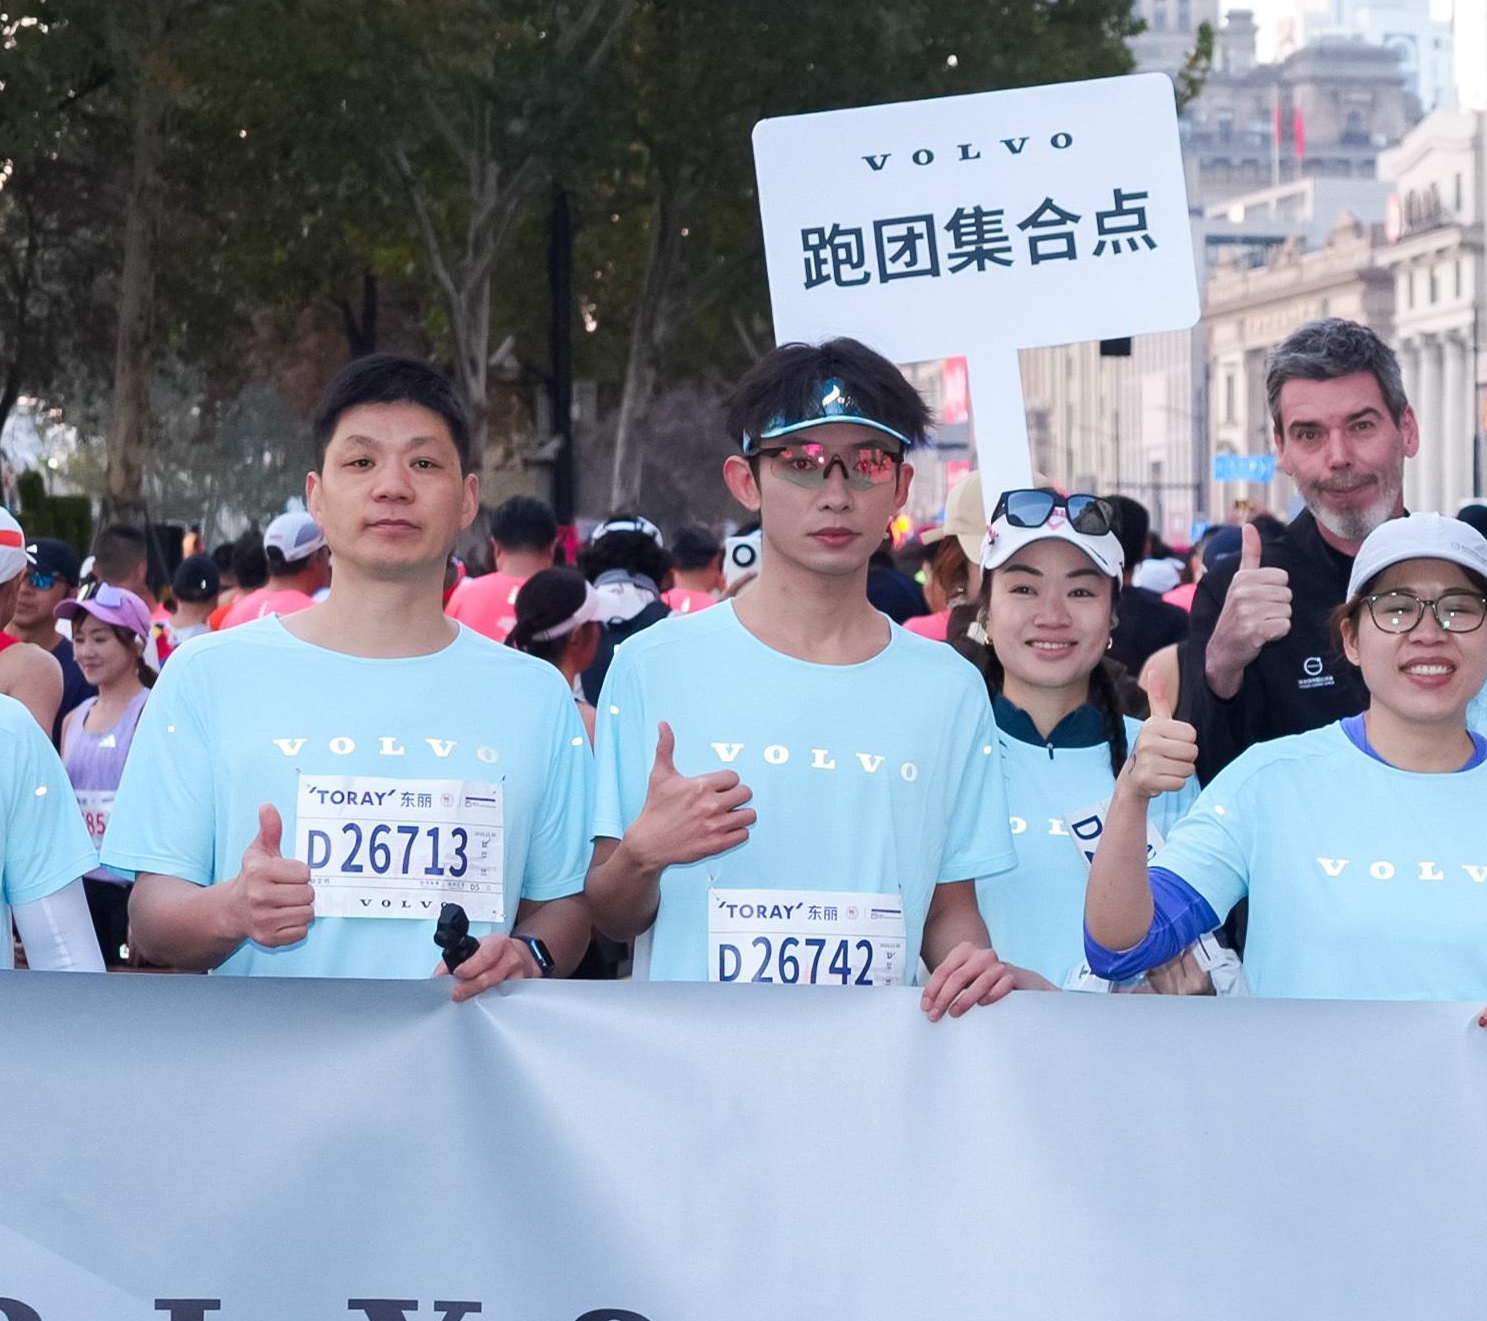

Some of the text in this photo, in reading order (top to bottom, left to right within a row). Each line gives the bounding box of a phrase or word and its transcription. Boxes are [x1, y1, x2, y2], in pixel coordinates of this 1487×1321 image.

[861, 132, 1074, 171] VOLVO
[800, 188, 1159, 290] 跑团集合点
[273, 737, 498, 764] VOLVO
[711, 742, 918, 781] VOLVO
[400, 791, 432, 808] 东丽
[307, 822, 468, 878] D26713
[807, 905, 838, 921] 东丽
[719, 936, 873, 986] D26742
